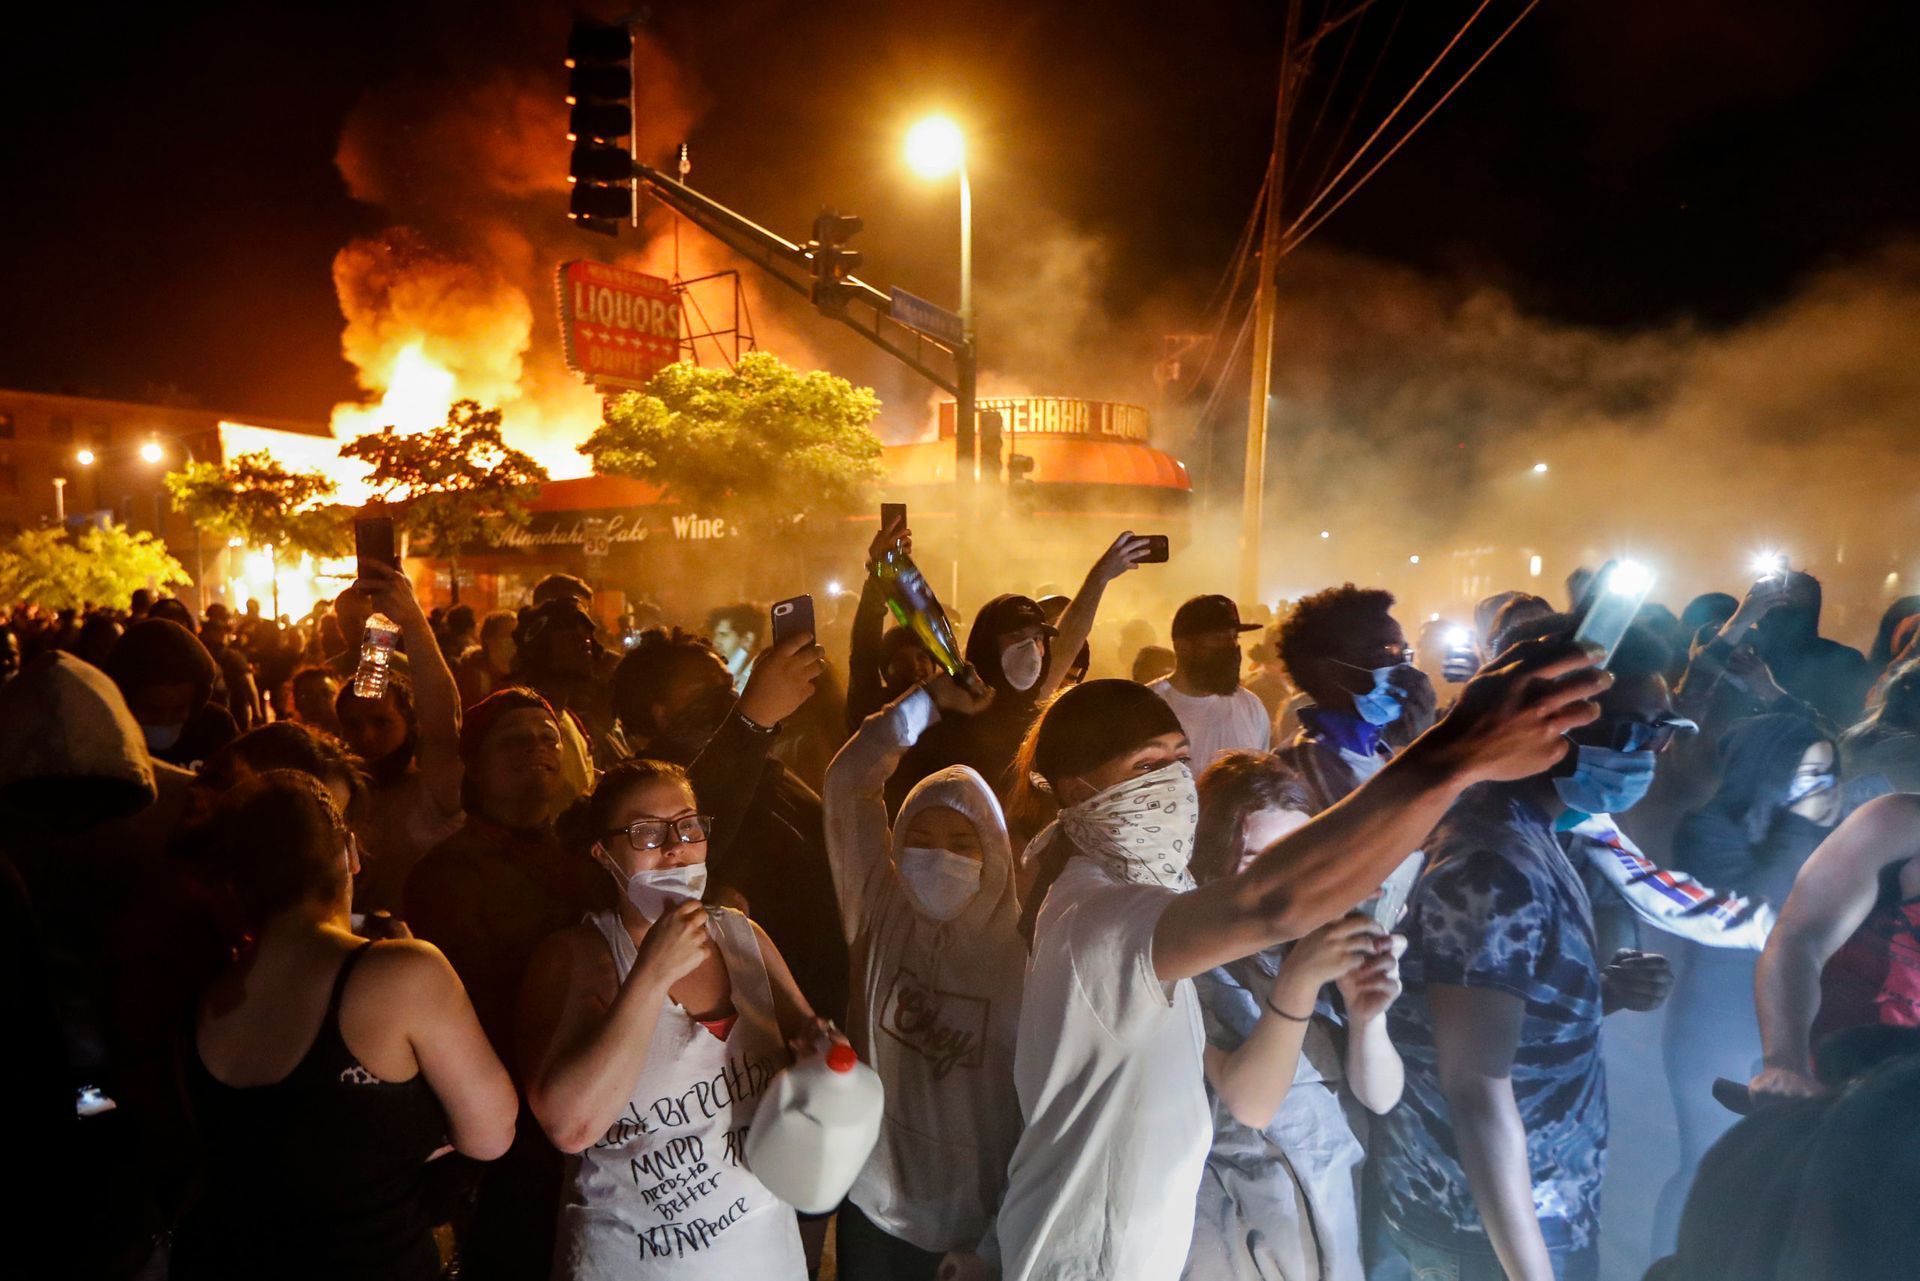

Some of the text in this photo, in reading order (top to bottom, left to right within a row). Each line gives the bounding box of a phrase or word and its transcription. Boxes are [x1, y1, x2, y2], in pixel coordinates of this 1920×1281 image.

[575, 281, 678, 338] LIQUORS
[497, 521, 584, 547] Minnehah
[606, 515, 650, 543] Lake
[672, 513, 725, 540] Wine
[630, 1135, 704, 1186] MNPD
[685, 1162, 708, 1180] to
[653, 1171, 721, 1221] Better
